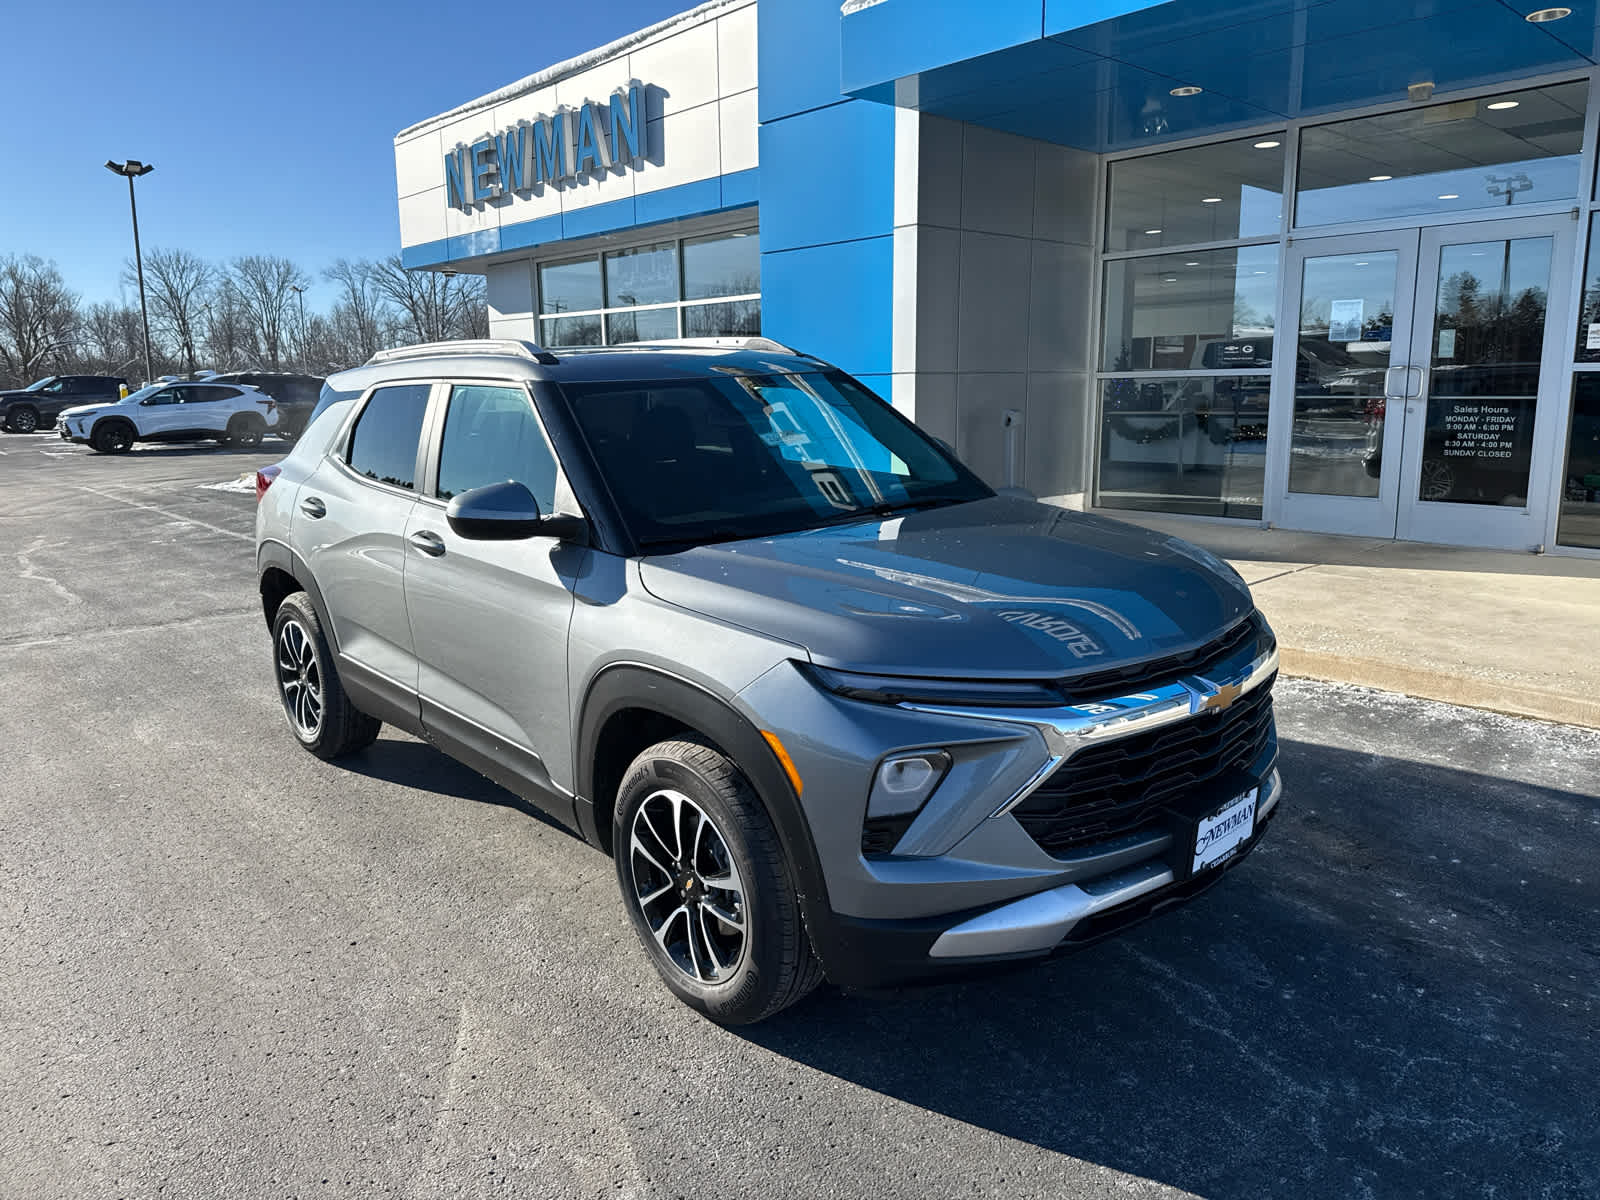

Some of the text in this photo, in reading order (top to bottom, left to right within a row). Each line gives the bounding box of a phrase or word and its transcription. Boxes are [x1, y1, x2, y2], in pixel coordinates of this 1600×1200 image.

[445, 86, 641, 209] NEWMAN
[1477, 450, 1512, 458] CLOSED
[1205, 802, 1255, 841] NEWMAN
